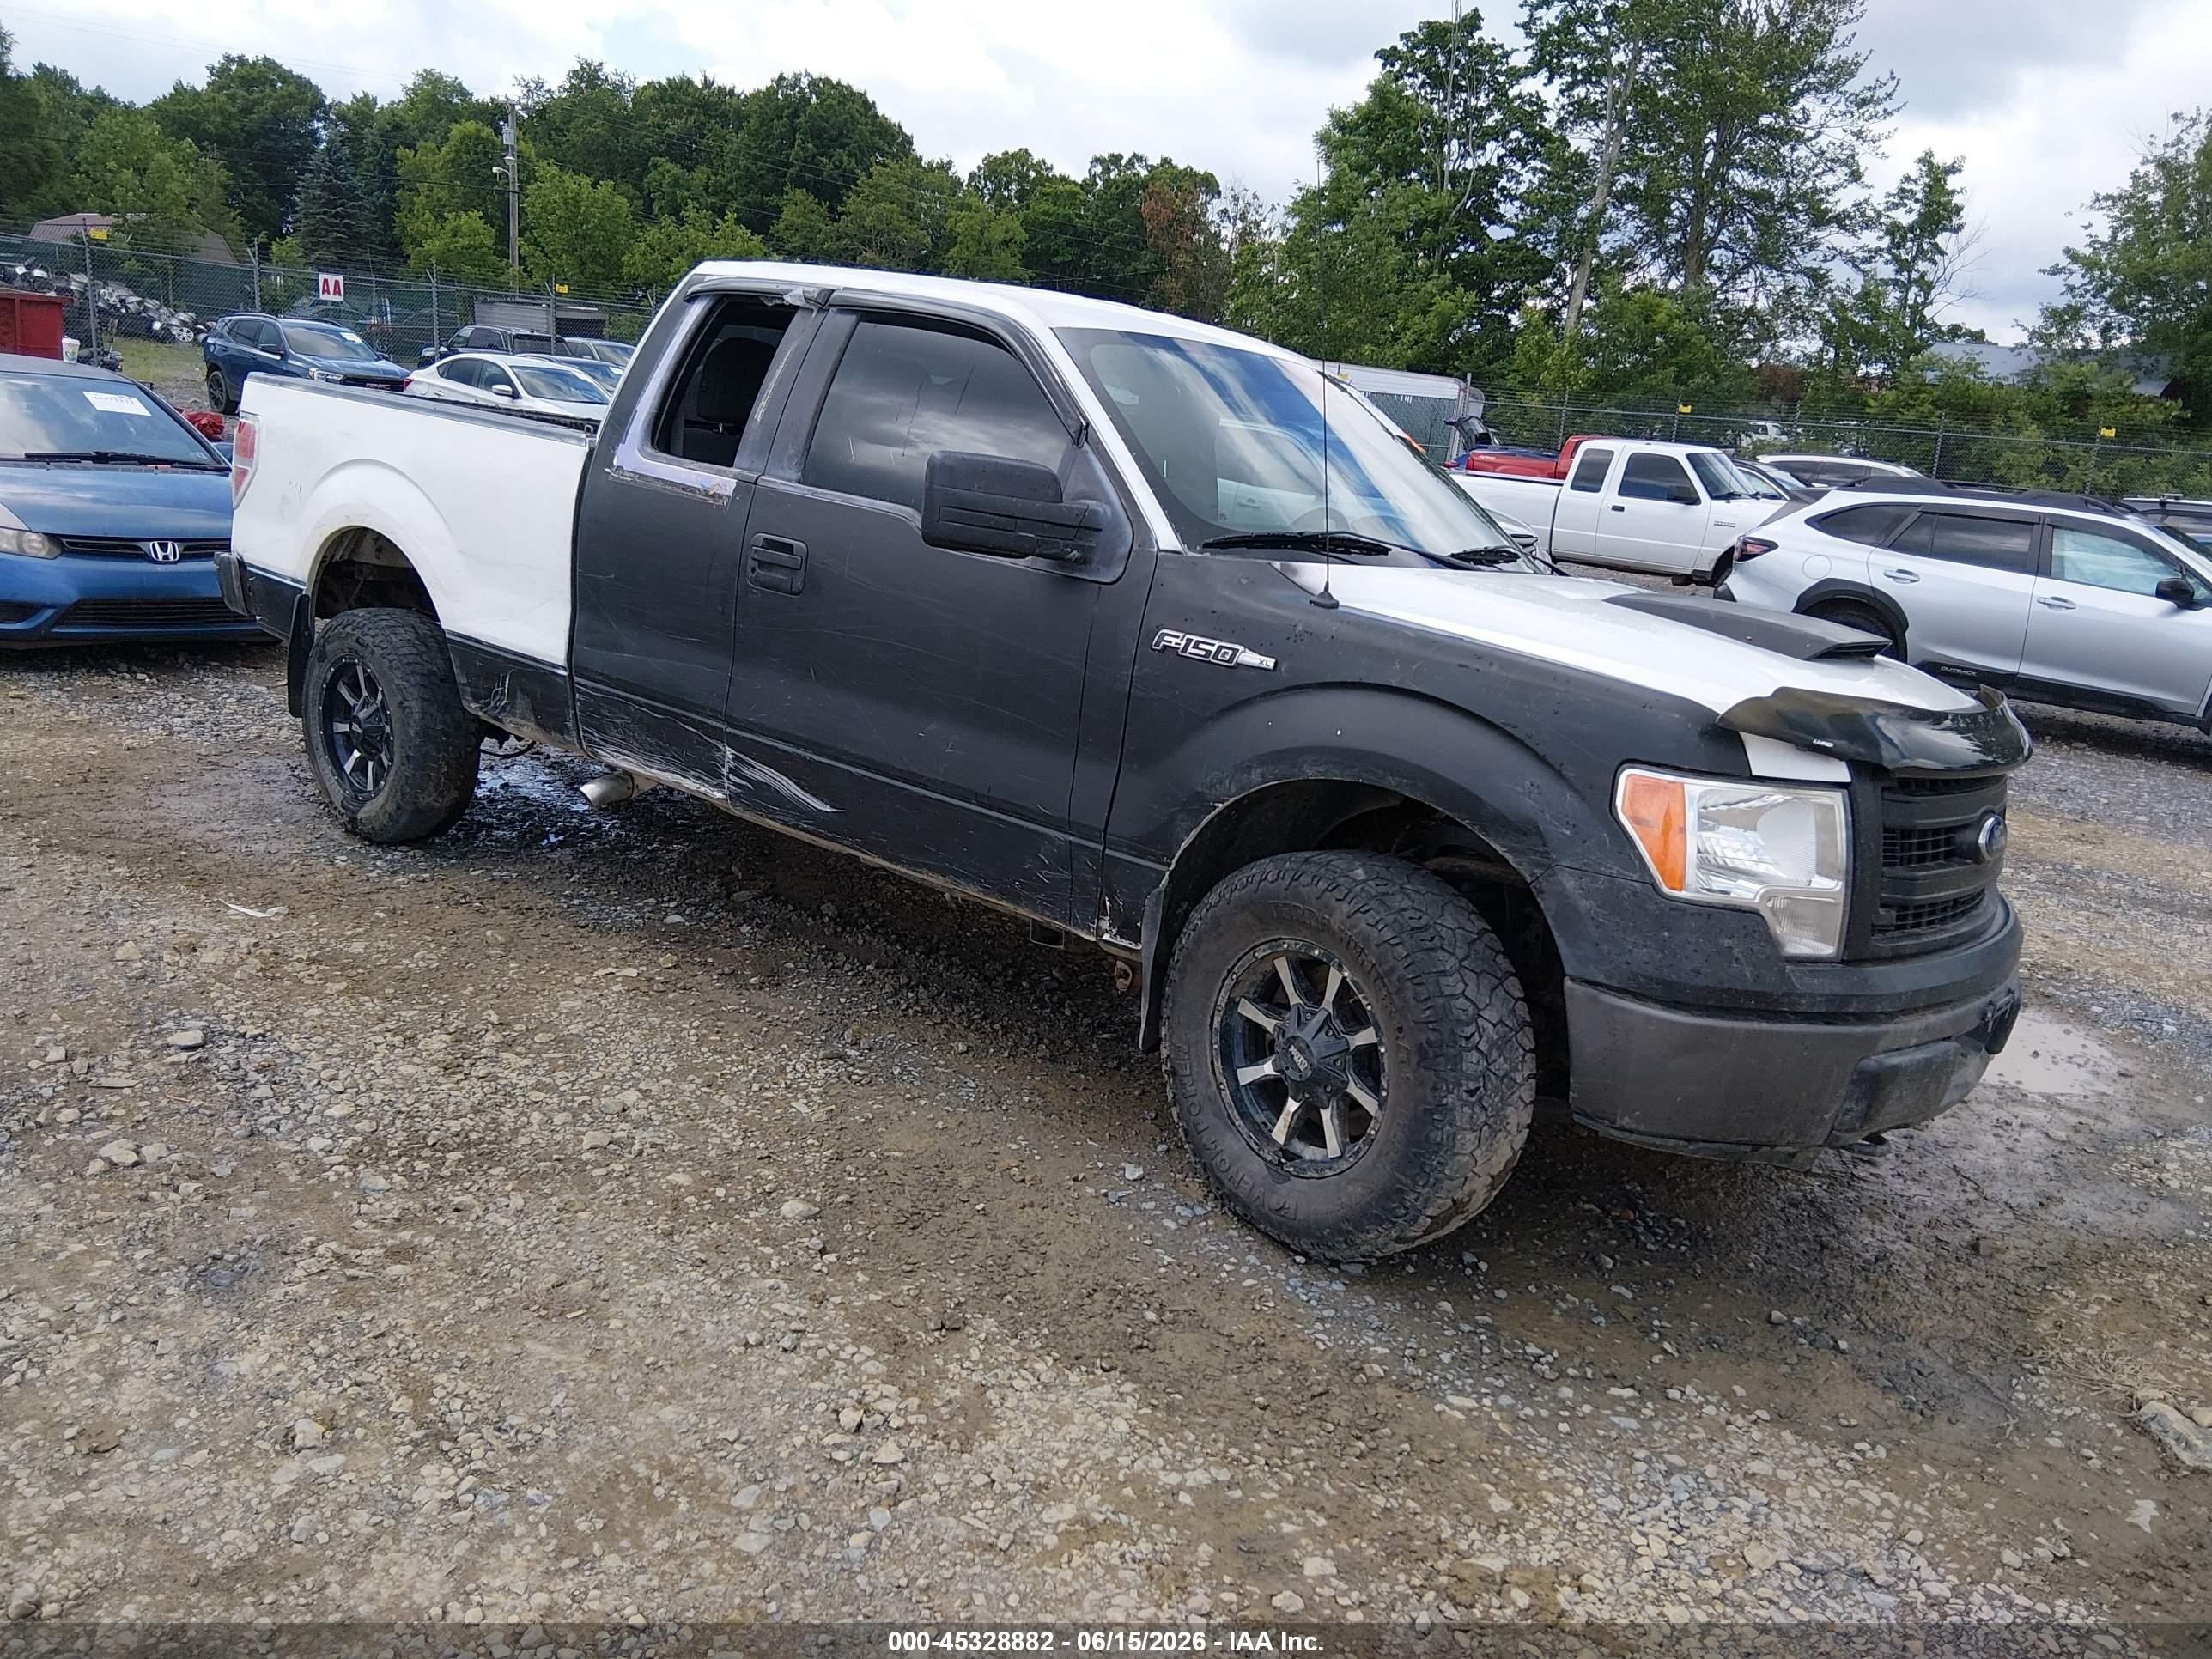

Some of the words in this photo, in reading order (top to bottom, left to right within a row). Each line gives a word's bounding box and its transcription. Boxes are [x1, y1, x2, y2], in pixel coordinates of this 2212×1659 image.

[322, 278, 342, 296] AA
[1151, 629, 1244, 666] F-150
[1258, 659, 1271, 667] XL
